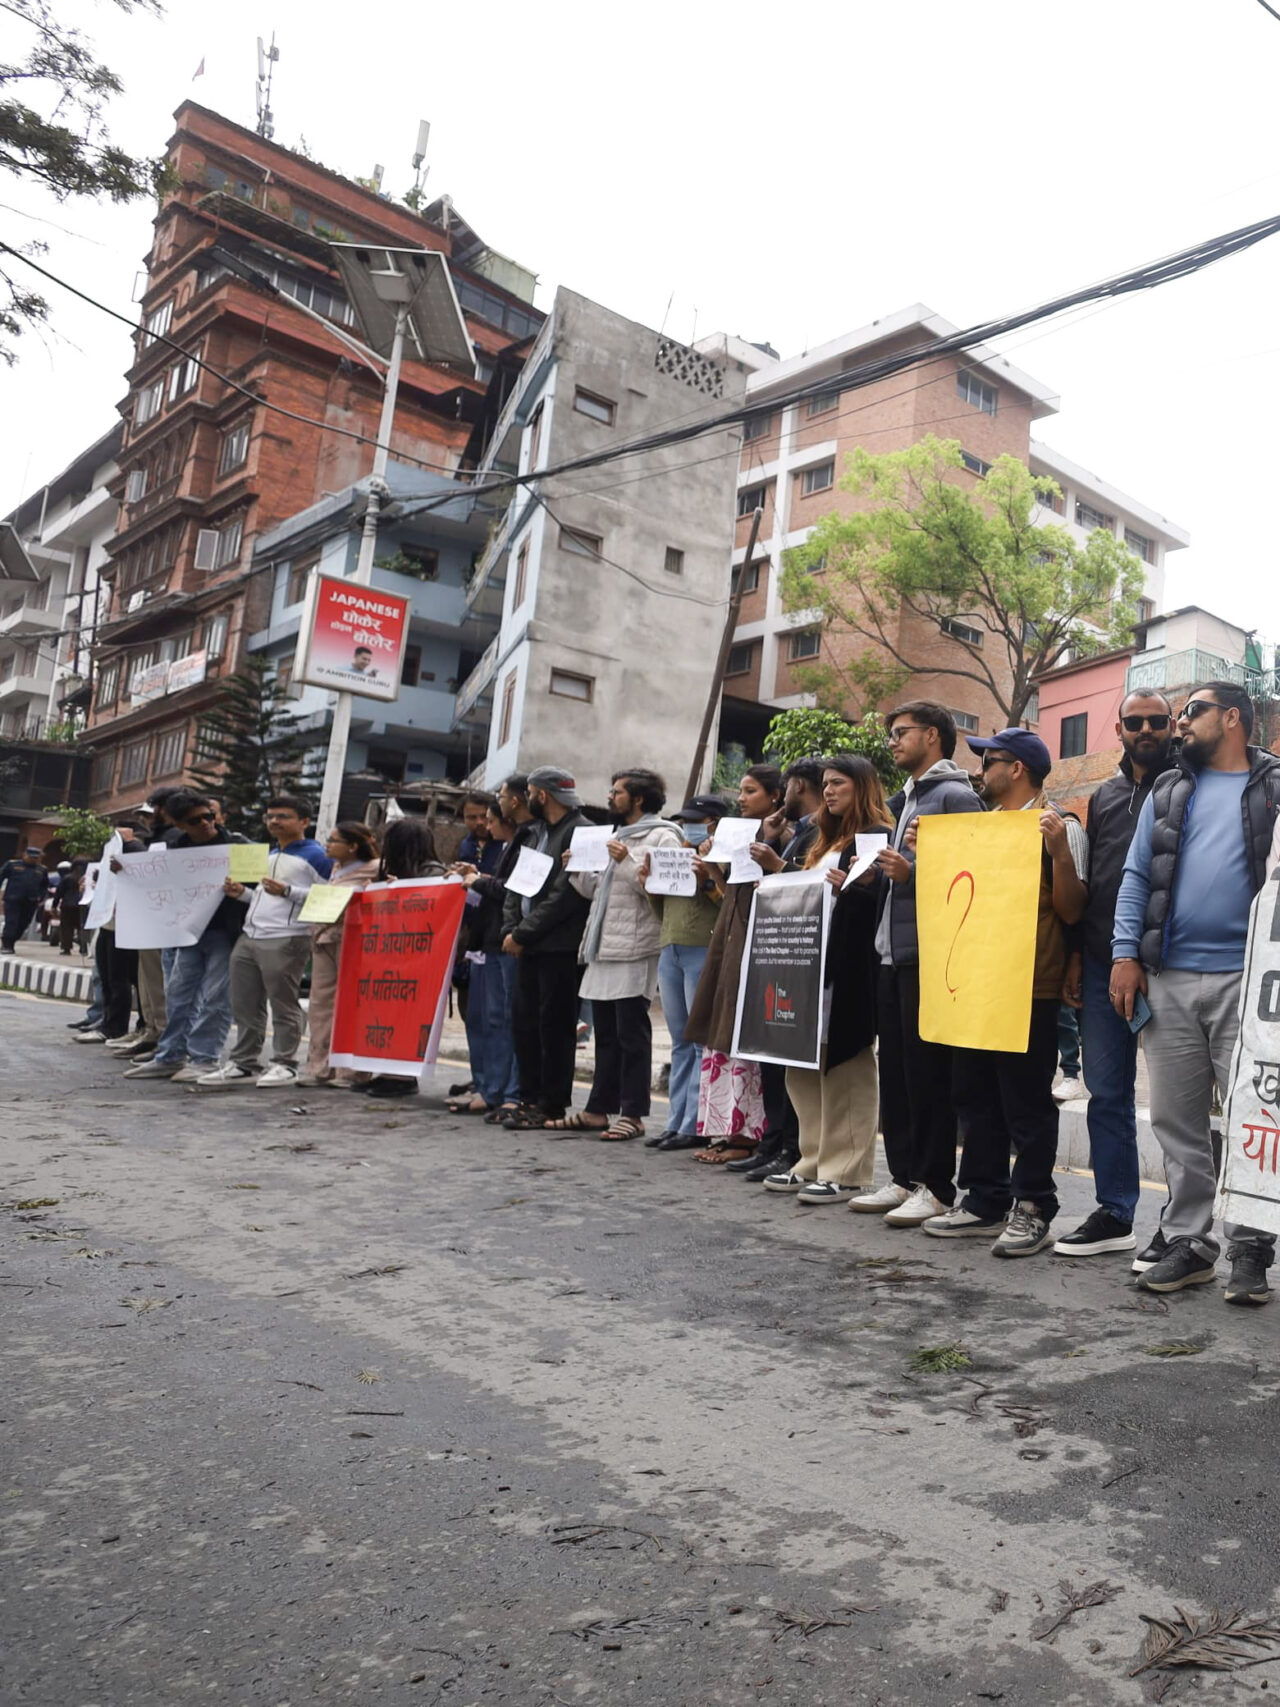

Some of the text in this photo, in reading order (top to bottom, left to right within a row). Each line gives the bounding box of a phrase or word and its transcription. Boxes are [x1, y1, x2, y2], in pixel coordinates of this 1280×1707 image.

[329, 591, 400, 619] JAPANESE
[353, 630, 395, 652] बोलेर
[325, 668, 366, 683] AMBITION
[776, 1008, 796, 1021] Chapter
